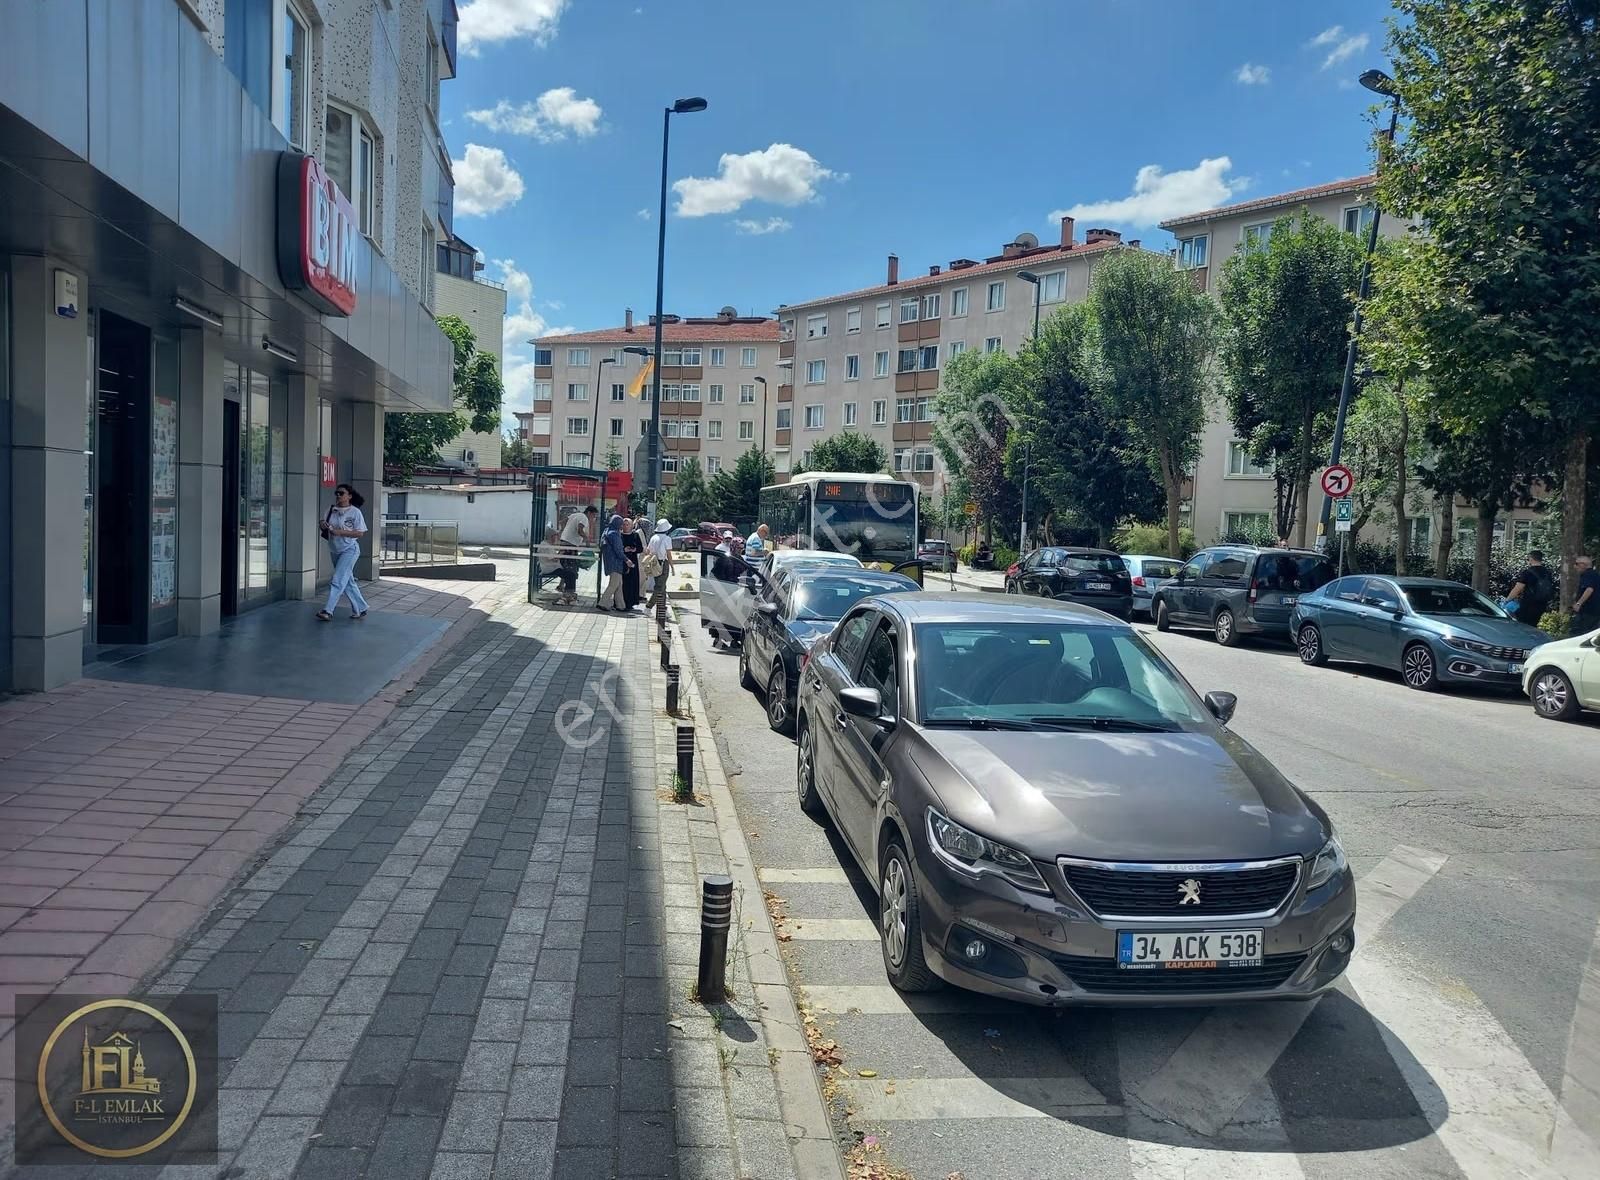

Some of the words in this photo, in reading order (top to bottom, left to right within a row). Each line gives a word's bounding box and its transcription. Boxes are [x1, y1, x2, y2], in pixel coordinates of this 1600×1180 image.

[1136, 936, 1161, 960] 34
[1172, 935, 1210, 960] ACK
[1220, 934, 1257, 958] 538
[1165, 960, 1217, 969] KAPLANLAR
